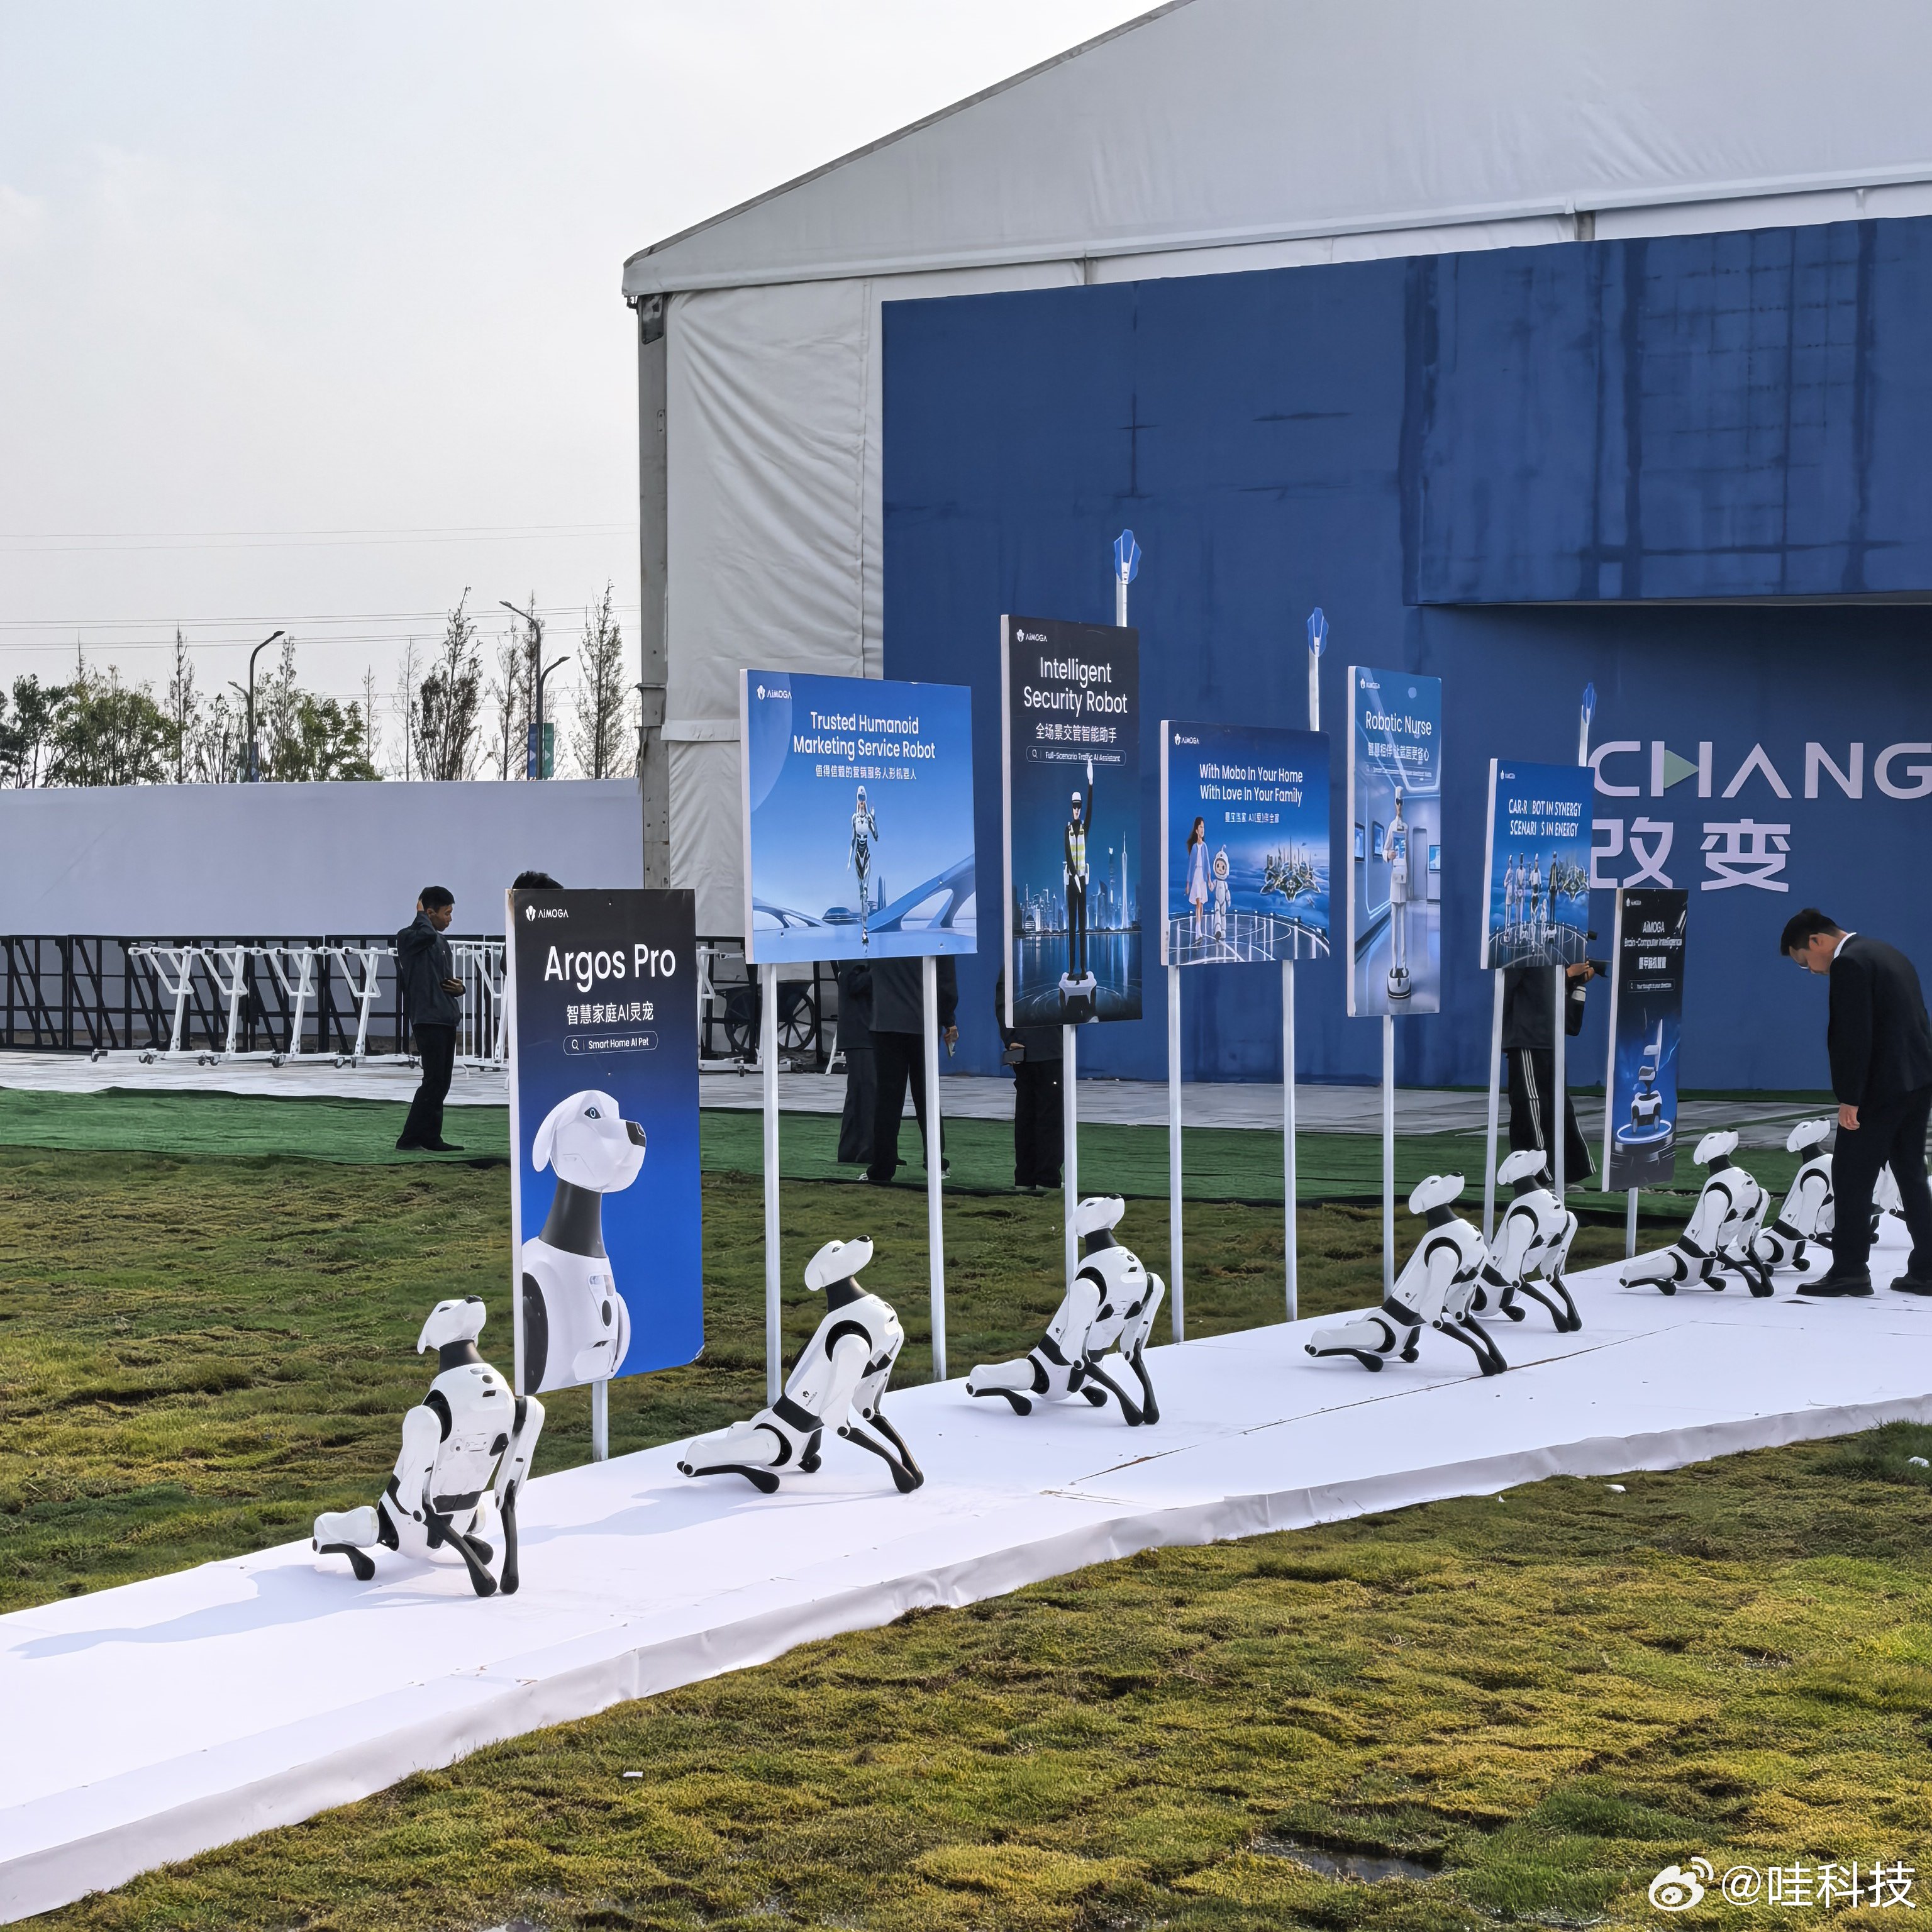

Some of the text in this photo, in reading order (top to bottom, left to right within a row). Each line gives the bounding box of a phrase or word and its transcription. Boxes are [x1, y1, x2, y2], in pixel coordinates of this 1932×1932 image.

[1040, 657, 1112, 688] Intelligent
[1024, 686, 1128, 718] Security Robot
[810, 711, 919, 735] Trusted Humanoid
[1036, 723, 1117, 743] 全场景交管智能助手
[1366, 711, 1432, 735] Robotic Nurse
[793, 735, 936, 761] Marketing Service Robot
[1199, 763, 1303, 783] With Mobo In Your Home
[1200, 784, 1302, 808] With Love In Your Family
[1546, 801, 1553, 816] IN
[1555, 801, 1582, 817] SYNERGY
[1546, 821, 1554, 836] IN
[1555, 822, 1579, 837] ENERGY
[1590, 817, 1791, 892] 改变
[544, 944, 676, 992] Argos Pro
[567, 1001, 654, 1025] 智慧家庭AI灵宠
[589, 1040, 609, 1049] Smart
[610, 1038, 630, 1048] Home
[638, 1037, 649, 1046] Pet
